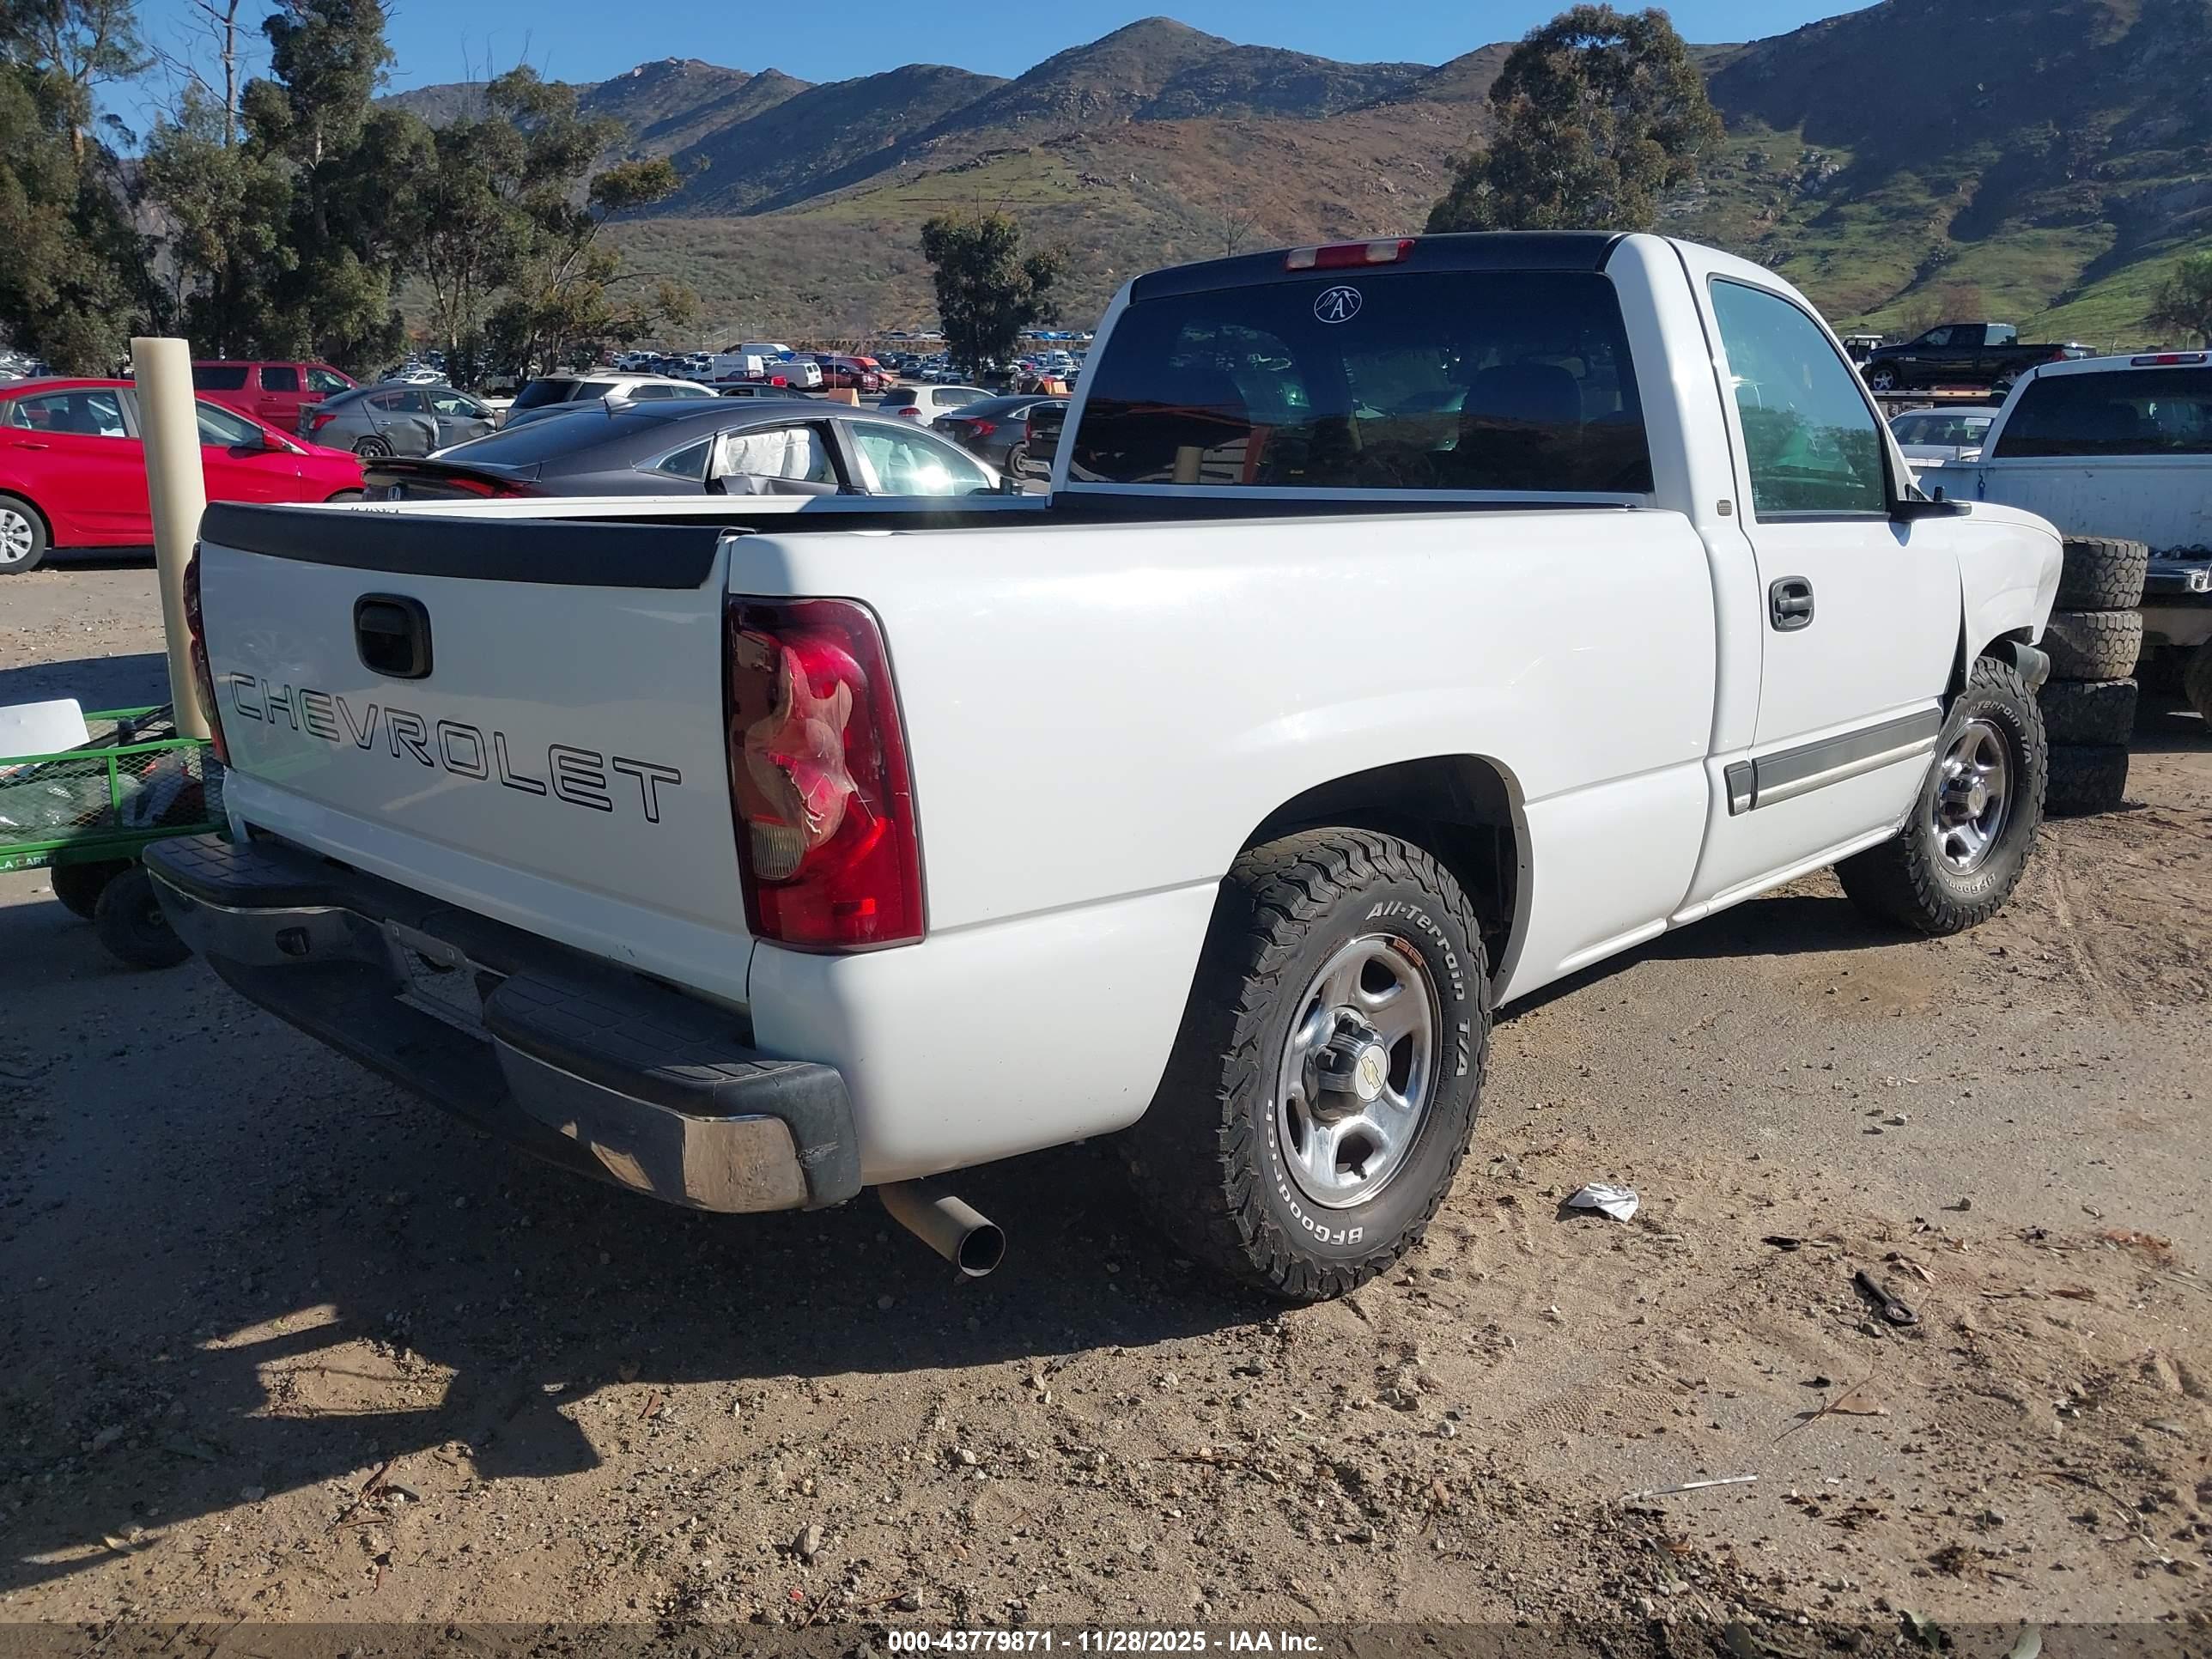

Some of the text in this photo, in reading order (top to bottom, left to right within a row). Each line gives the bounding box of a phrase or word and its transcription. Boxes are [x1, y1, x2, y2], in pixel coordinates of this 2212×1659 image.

[229, 671, 682, 824] CHEVROLET
[2019, 734, 2033, 764] T/A
[1364, 900, 1467, 1001] All-Terrain
[1455, 1018, 1471, 1078] T/A
[1264, 1099, 1364, 1246] BFGoodrich
